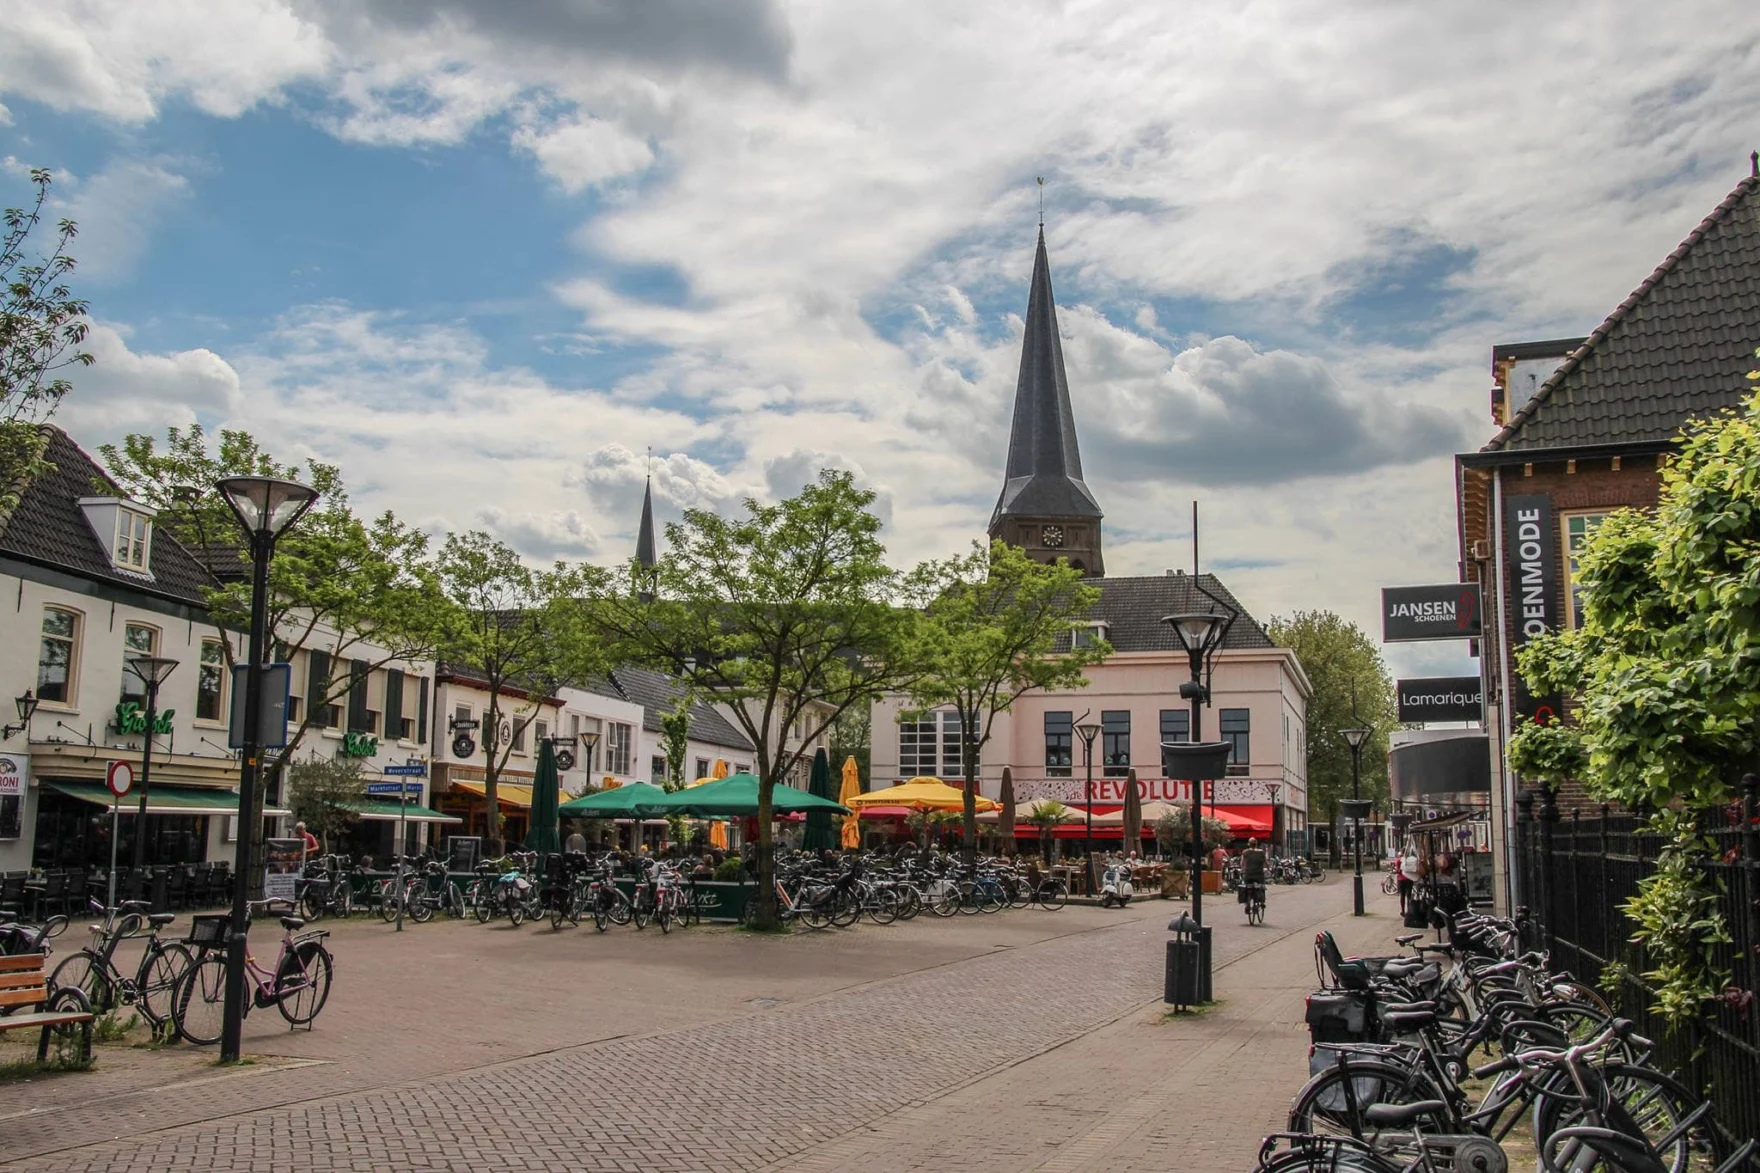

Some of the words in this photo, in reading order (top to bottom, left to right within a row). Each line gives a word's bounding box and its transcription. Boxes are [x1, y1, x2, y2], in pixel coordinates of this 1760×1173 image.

[1518, 508, 1546, 645] OENMODE
[1390, 601, 1456, 617] JANSEN
[1414, 614, 1456, 622] SCHOENEN
[1402, 691, 1482, 707] Lamarique
[1084, 780, 1213, 800] REVOLUTE
